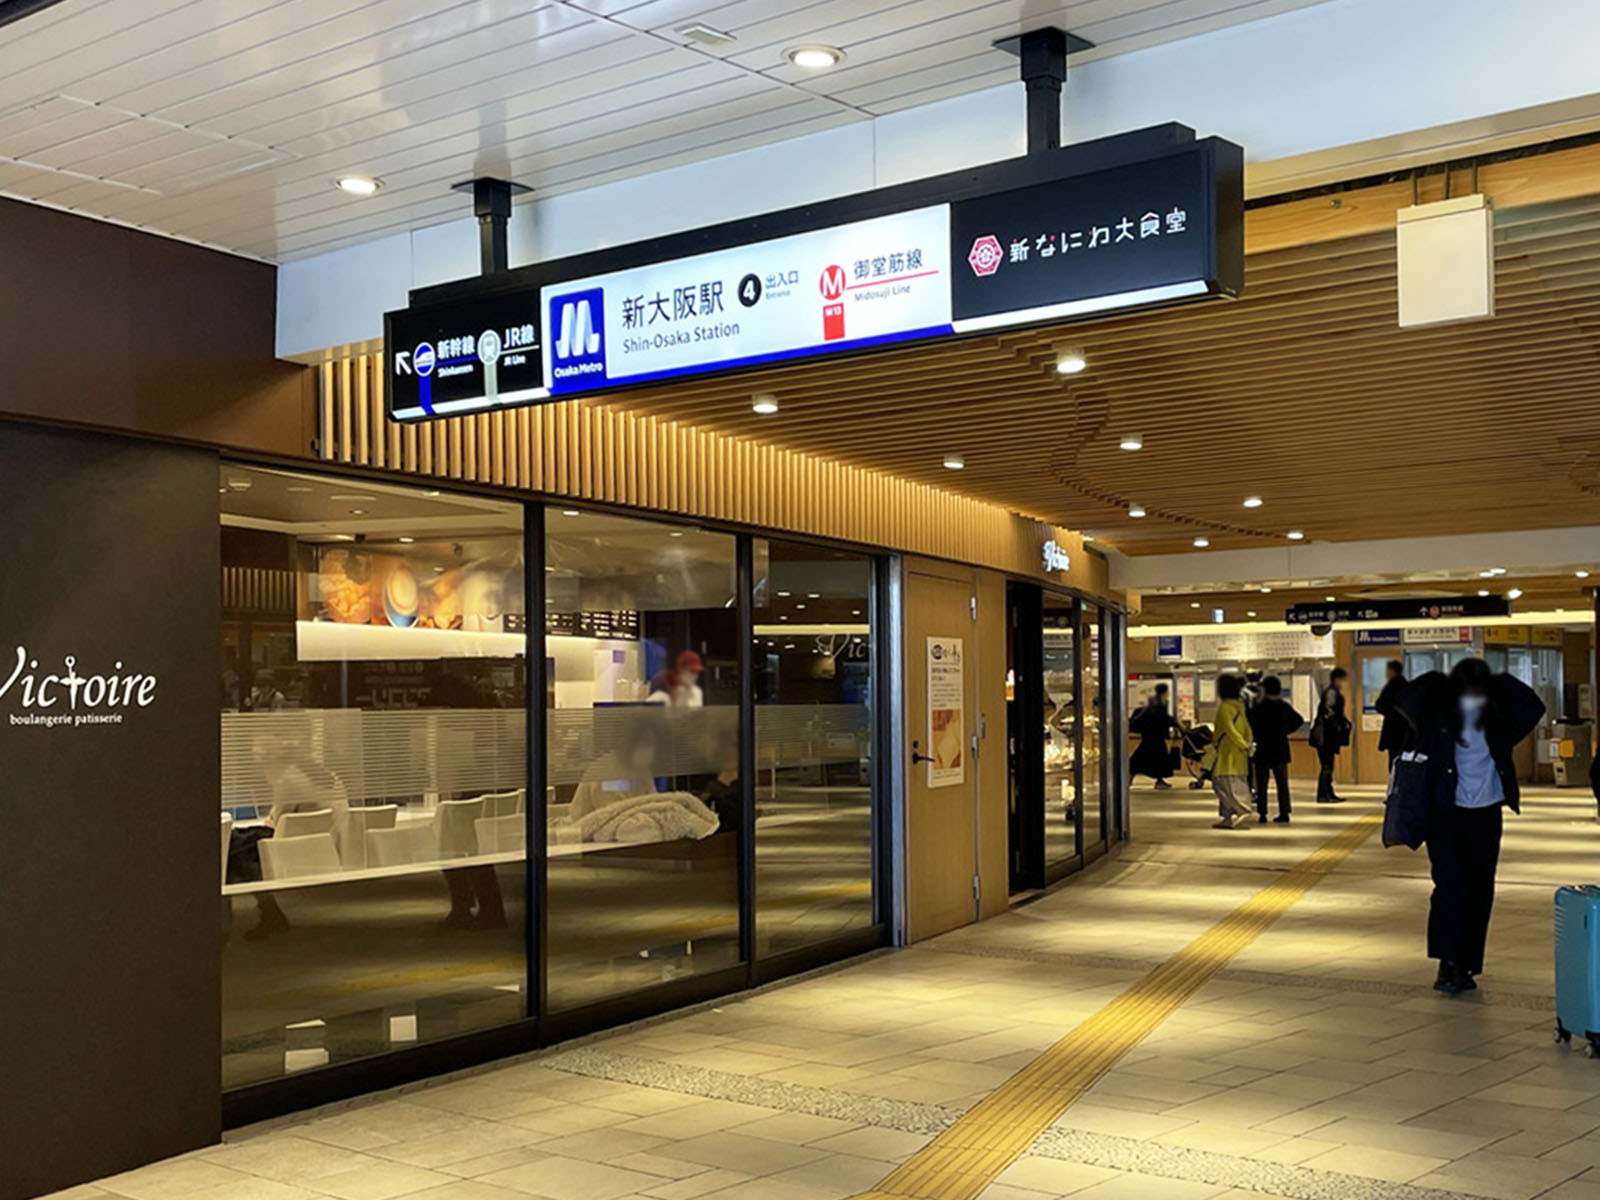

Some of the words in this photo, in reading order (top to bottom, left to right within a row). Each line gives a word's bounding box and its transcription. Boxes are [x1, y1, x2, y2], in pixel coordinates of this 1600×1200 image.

[1009, 207, 1187, 263] 新なにわ大食堂
[853, 248, 923, 280] 御堂筋線
[765, 269, 799, 289] 出入口
[892, 284, 911, 296] Line
[622, 280, 724, 330] 新大阪駅
[503, 324, 535, 349] JR線
[623, 330, 691, 354] Shin-Osaka
[693, 321, 740, 343] Station
[554, 366, 578, 379] Osaka
[578, 362, 603, 375] Metro
[10, 714, 72, 727] boulangerie
[74, 713, 123, 726] patisserie
